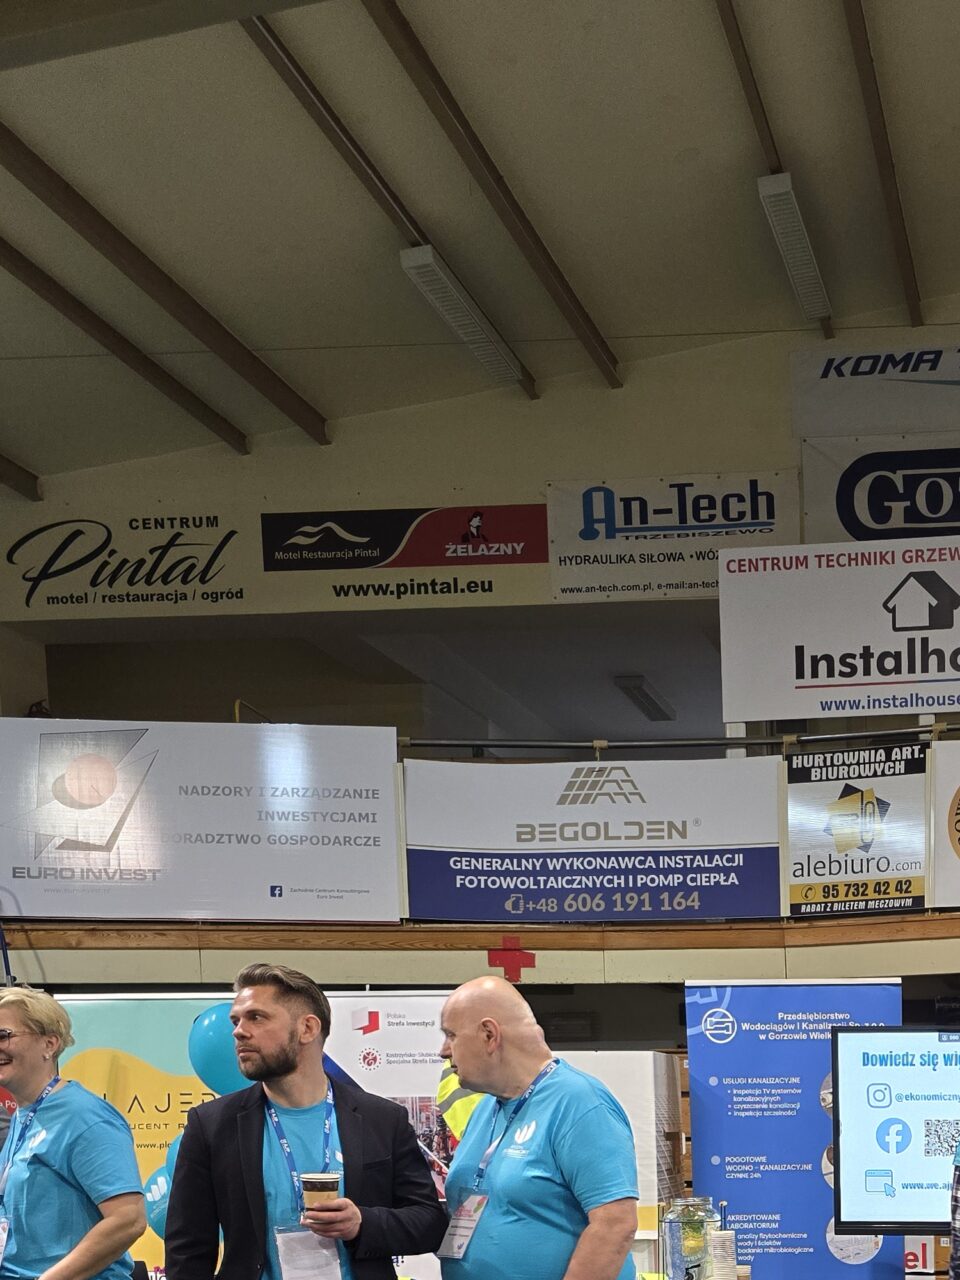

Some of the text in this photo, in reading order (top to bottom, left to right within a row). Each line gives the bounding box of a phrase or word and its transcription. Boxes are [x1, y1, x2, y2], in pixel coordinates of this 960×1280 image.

[820, 350, 943, 379] KOMA
[579, 479, 775, 541] An-Tech
[129, 516, 219, 530] CENTRUM
[620, 528, 774, 540] TRZEBISZEWO
[274, 548, 380, 560] Motel Restauracja Pintal
[445, 542, 525, 557] ŻELAZNY
[558, 550, 685, 566] HYDRAULIKA SIŁOWA
[6, 519, 238, 608] Pintal
[726, 555, 809, 574] CENTRUM
[814, 551, 896, 570] TECHNIKI
[46, 588, 243, 605] motel restauracja ogród
[332, 577, 493, 599] www.pintal.eu
[792, 746, 924, 768] HURTOWNIA ART.
[811, 761, 905, 781] BIUROWYCH
[178, 784, 380, 801] NADZORY ZARZĄDZANIE
[257, 810, 377, 824] INWESTYCJAMI
[267, 834, 381, 847] GOSPODARCZE
[516, 820, 687, 843] BEGOLDEN
[450, 853, 743, 871] GENERALNY WYKONAWCA INSTALACJI
[792, 853, 922, 878] alebiuro.com
[12, 867, 161, 881] EURO INVEST
[456, 872, 739, 890] FOTOWOLTAICZNYCH I POMP CIEPŁA
[822, 879, 912, 898] 95 732 42 42
[526, 891, 700, 913] +48 606 191 164
[801, 903, 824, 912] RABAT
[833, 902, 865, 910] BILETEM
[868, 898, 912, 909] MECZOWYM
[778, 1012, 850, 1021] Przedsiębiorstwo
[741, 1022, 795, 1031] Wodociągów
[862, 1051, 916, 1066] Dowiedz
[920, 1051, 939, 1072] się
